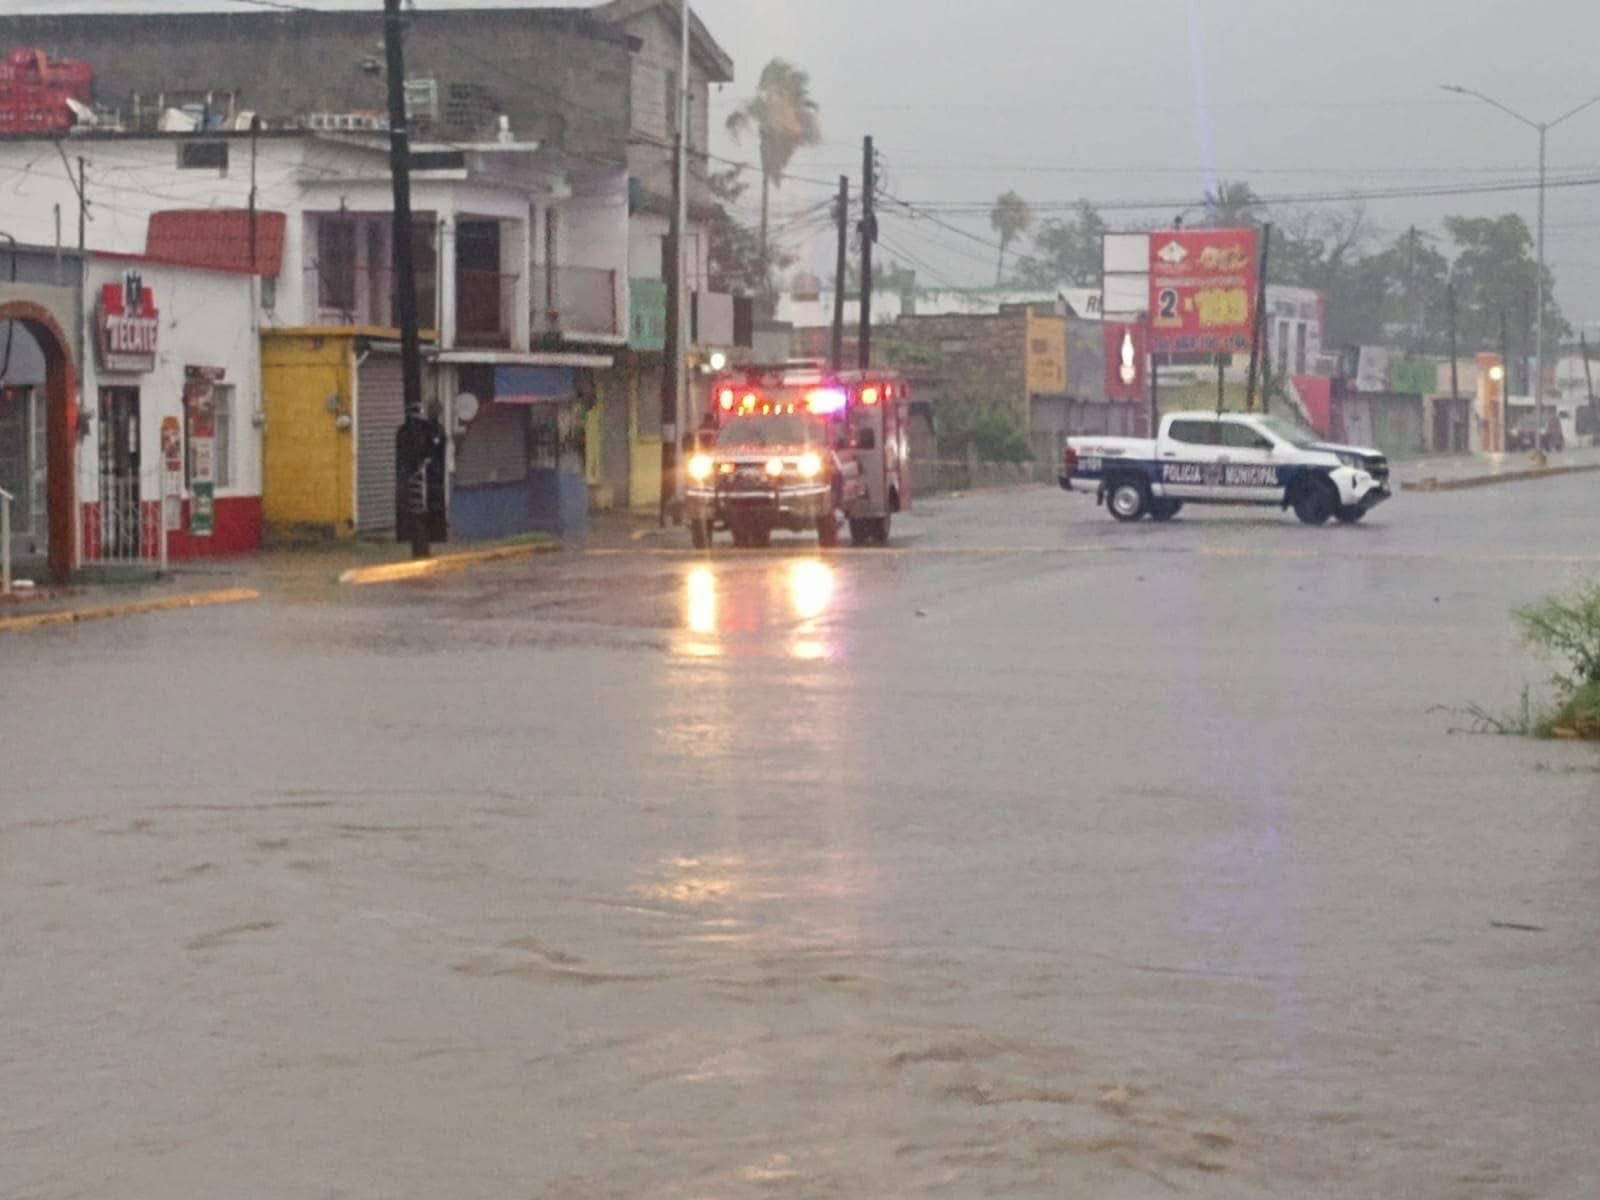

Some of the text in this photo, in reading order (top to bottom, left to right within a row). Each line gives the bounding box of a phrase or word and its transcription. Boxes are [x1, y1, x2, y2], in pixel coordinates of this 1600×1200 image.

[1159, 290, 1177, 318] 2
[106, 317, 159, 351] TECATE
[1225, 464, 1279, 485] MUNICIPAL
